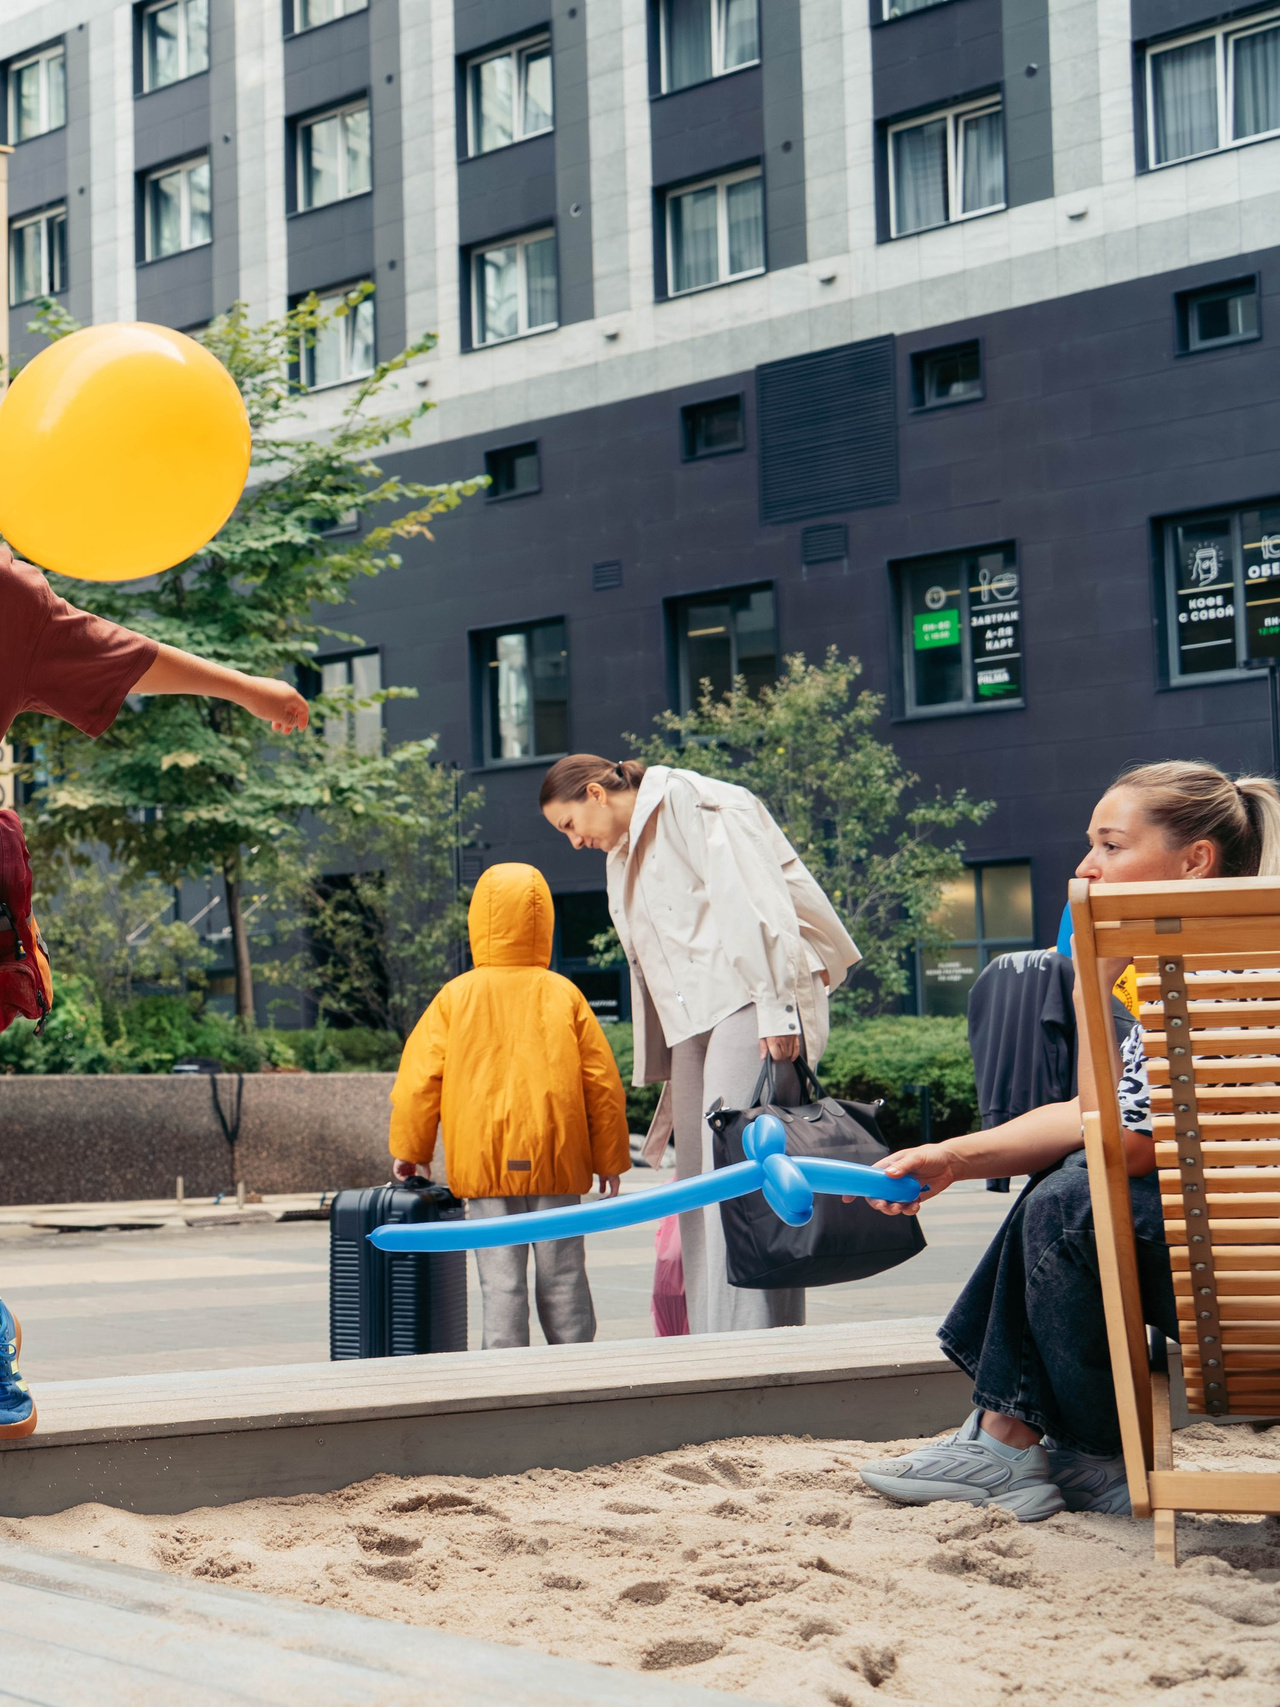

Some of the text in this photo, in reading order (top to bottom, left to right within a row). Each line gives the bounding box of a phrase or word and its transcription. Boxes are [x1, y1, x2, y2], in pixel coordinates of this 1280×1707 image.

[1188, 594, 1224, 610] КОФЕ
[970, 611, 1020, 627] ЗАВТРАК
[1178, 603, 1235, 624] С СОБОЙ
[985, 637, 1015, 652] КАРТ
